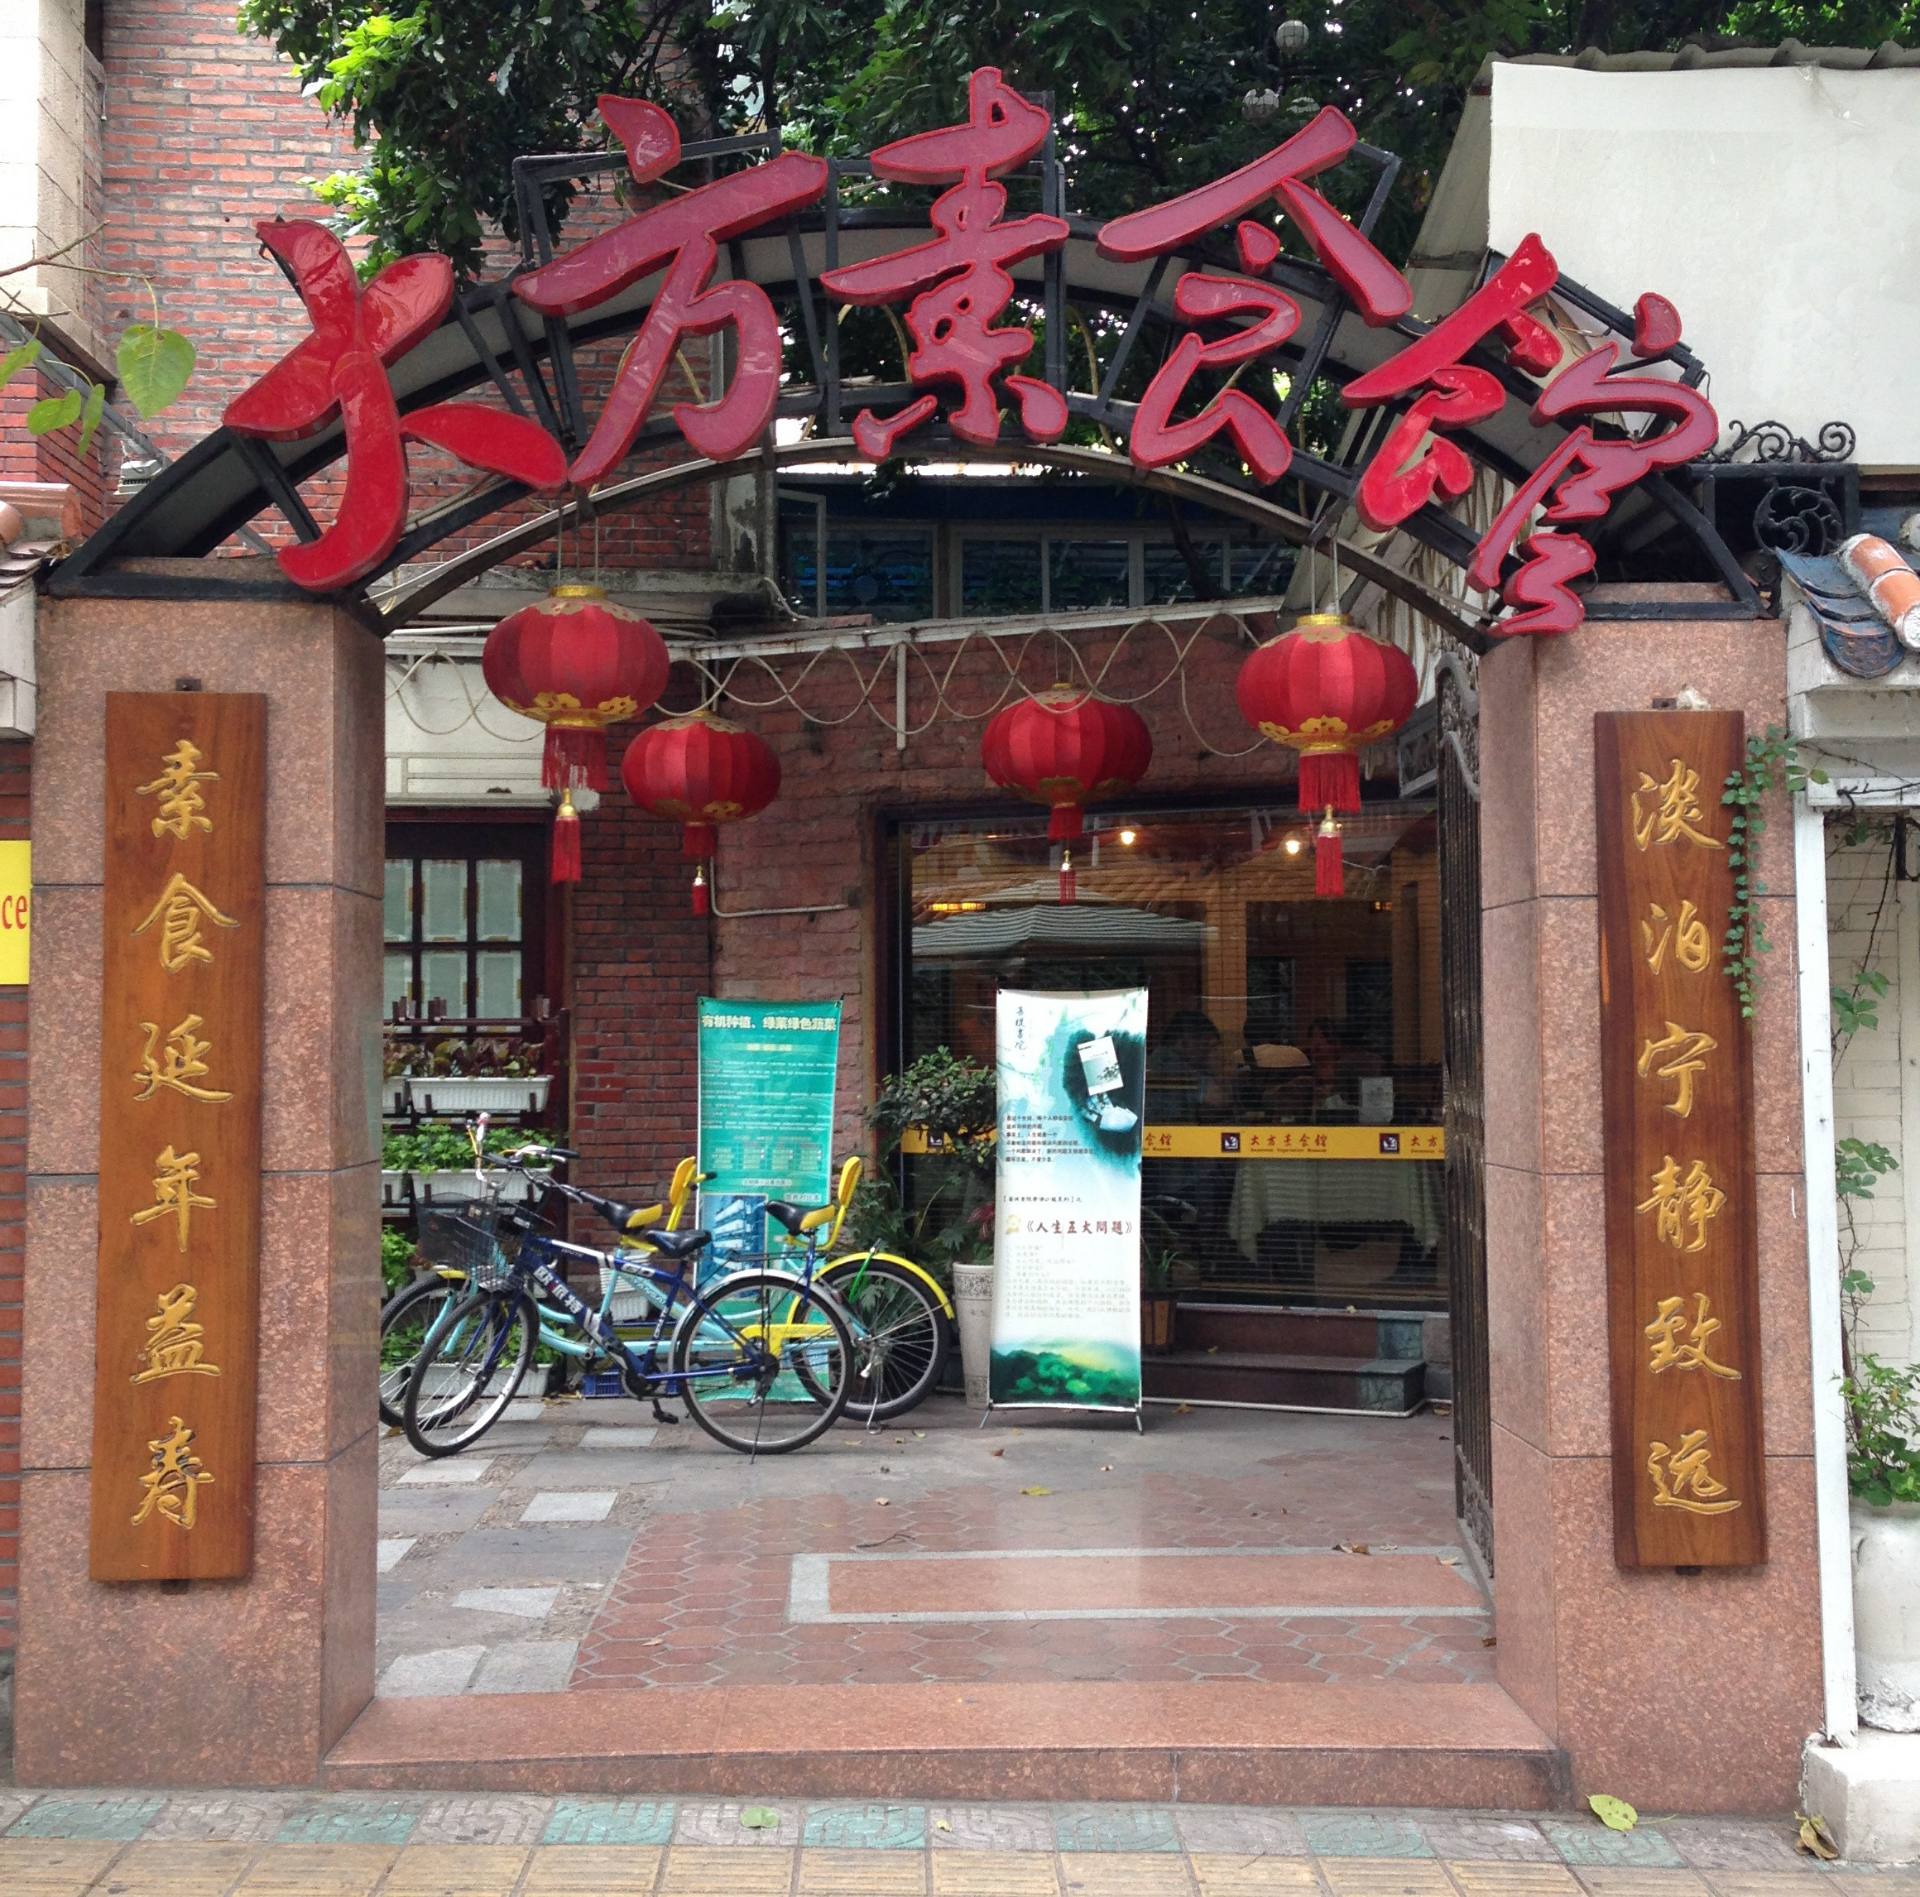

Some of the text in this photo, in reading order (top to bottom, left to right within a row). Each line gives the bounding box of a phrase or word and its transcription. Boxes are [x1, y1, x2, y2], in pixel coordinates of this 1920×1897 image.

[130, 739, 240, 1530] 素食延年益寿
